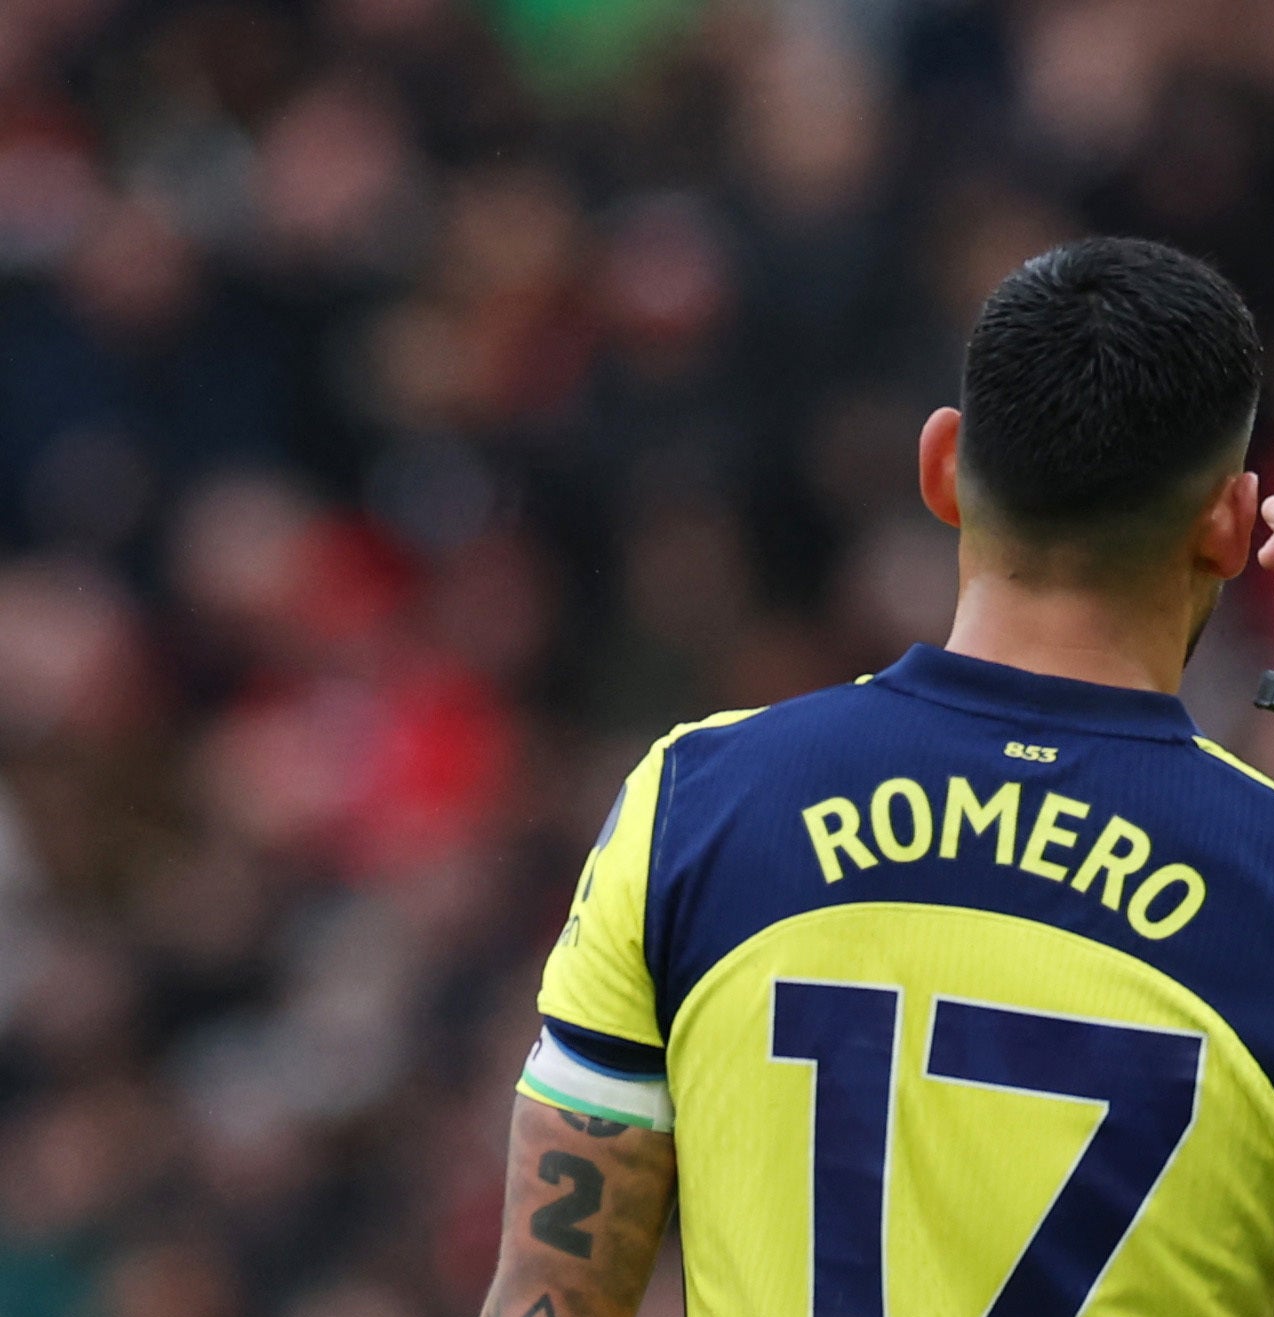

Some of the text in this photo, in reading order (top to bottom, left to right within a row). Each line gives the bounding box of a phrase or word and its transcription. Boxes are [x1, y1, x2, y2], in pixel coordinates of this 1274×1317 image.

[1003, 741, 1059, 763] 853
[802, 776, 1206, 941] ROMERO
[530, 1150, 605, 1260] 2
